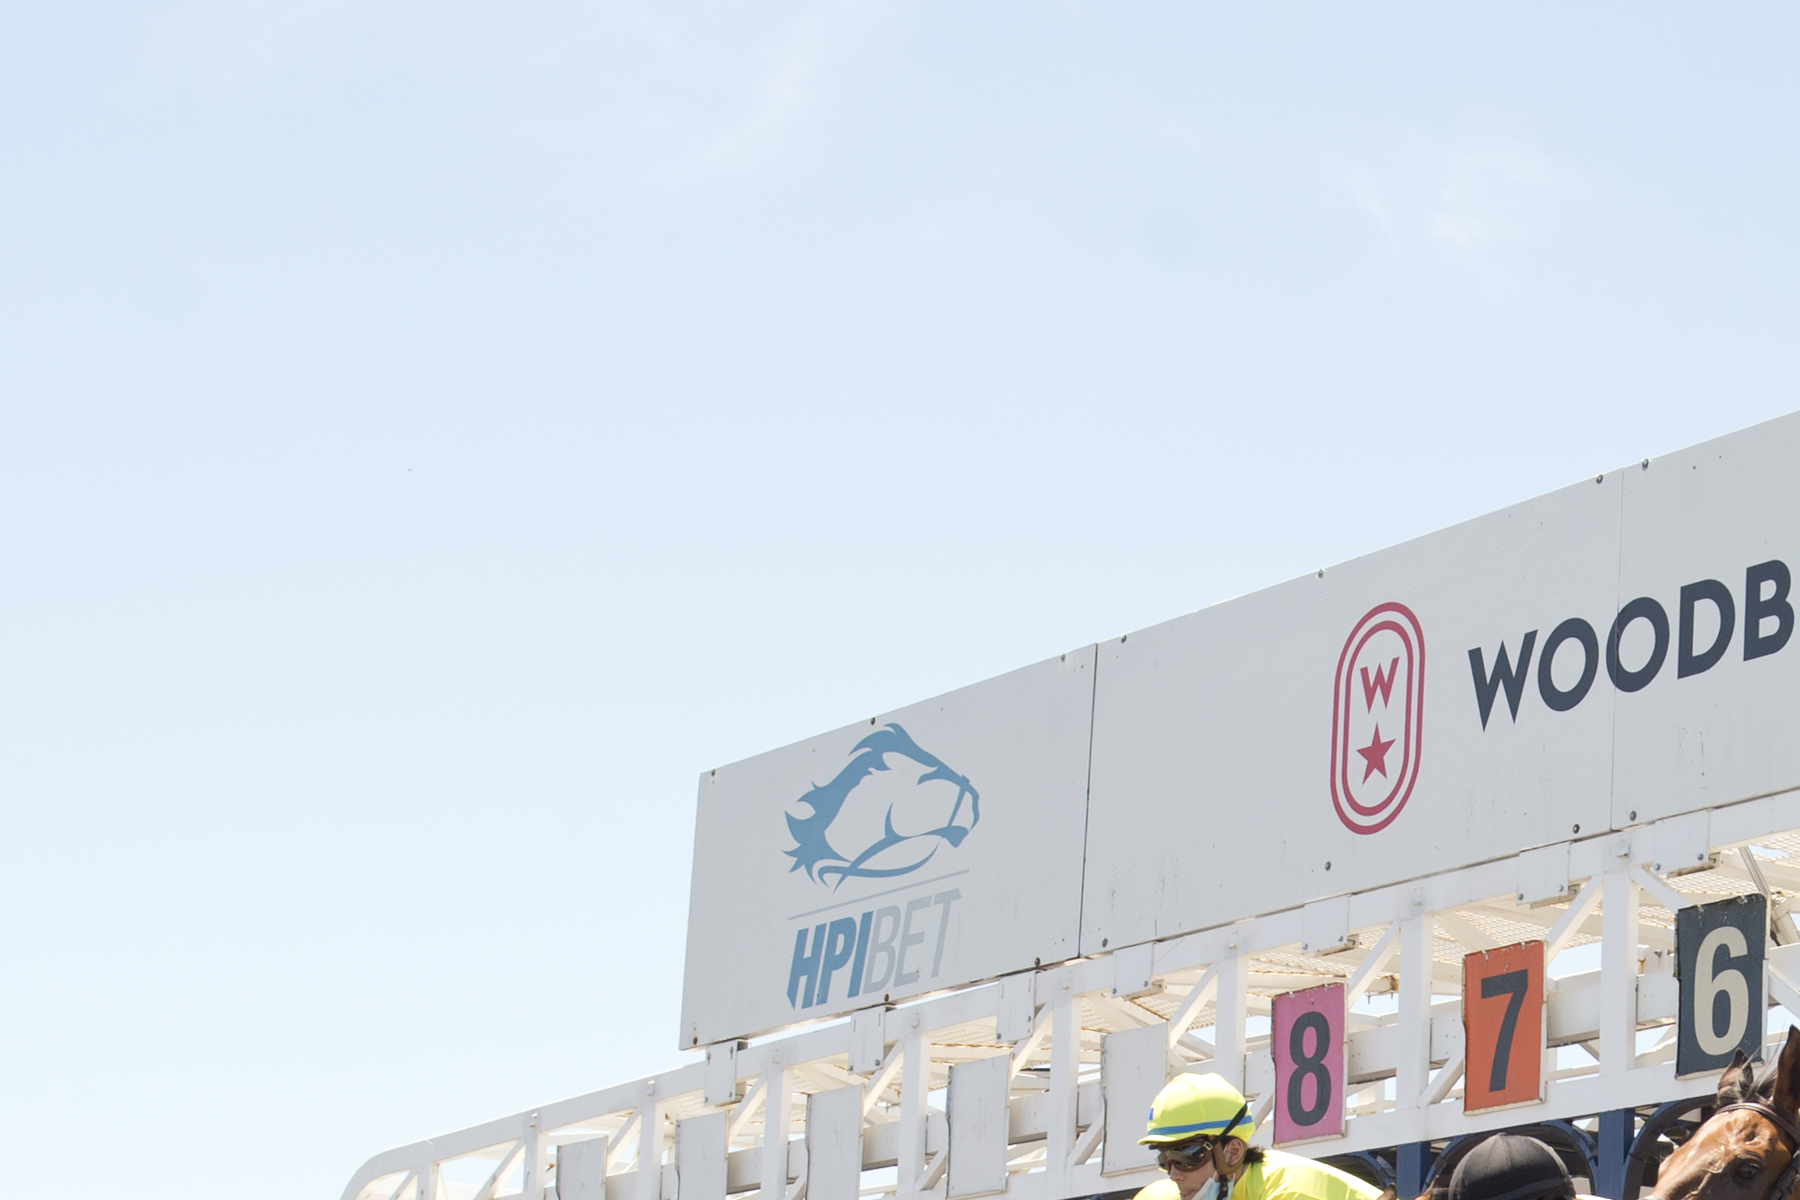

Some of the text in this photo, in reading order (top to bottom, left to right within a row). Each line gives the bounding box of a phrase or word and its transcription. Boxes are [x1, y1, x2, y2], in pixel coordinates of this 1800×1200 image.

[1360, 656, 1400, 714] W
[786, 887, 963, 1011] HPIBET
[1692, 926, 1750, 1056] 6
[1287, 1011, 1332, 1127] 8
[1480, 968, 1530, 1093] 7
